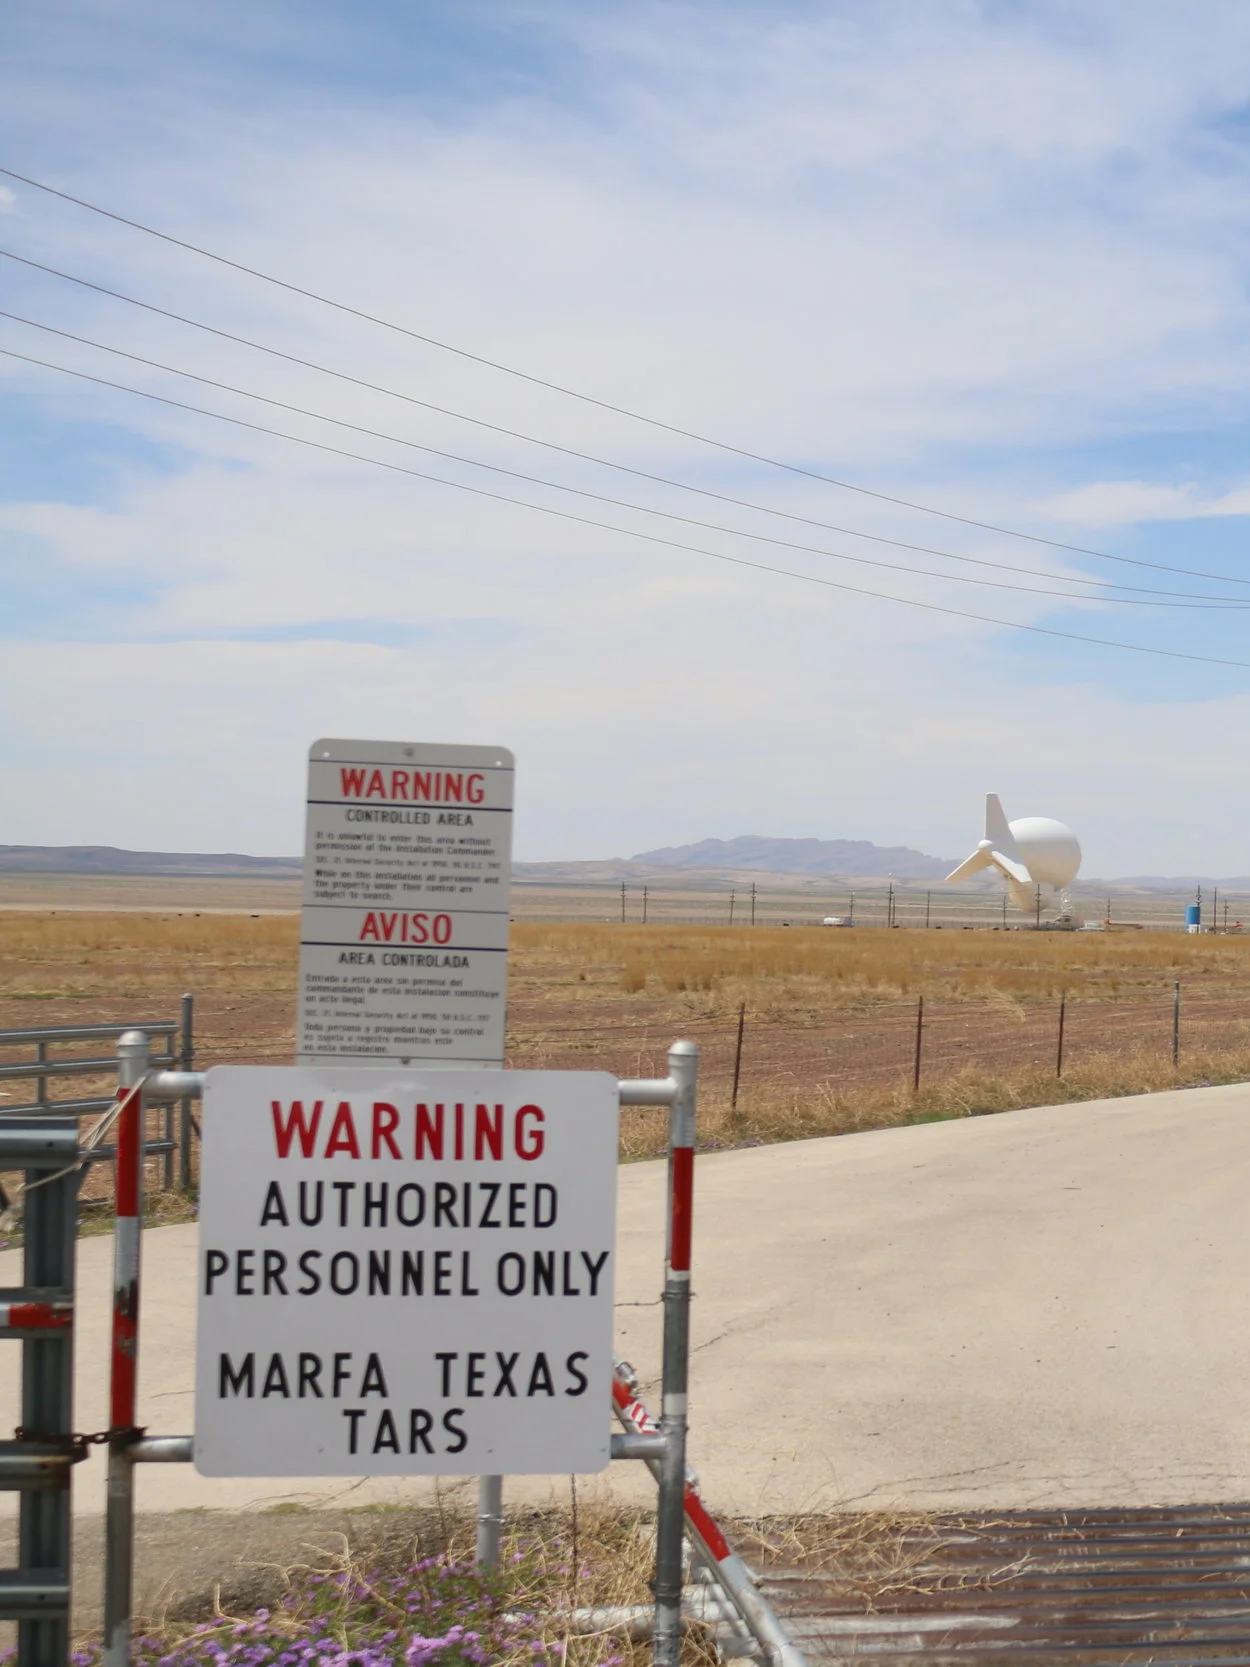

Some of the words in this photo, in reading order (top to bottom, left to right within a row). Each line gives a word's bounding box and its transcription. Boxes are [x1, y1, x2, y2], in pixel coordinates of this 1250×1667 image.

[340, 768, 484, 803] WARNING
[346, 810, 431, 825] CONTROLLED
[438, 814, 473, 826] AREA
[359, 912, 452, 944] AVISO
[339, 952, 374, 964] AREA
[382, 952, 470, 968] CONTROLADA
[271, 1100, 544, 1160] WARNING
[260, 1181, 557, 1228] AUTHORIZED
[205, 1250, 478, 1296] PERSONNEL
[498, 1251, 609, 1296] ONLY
[220, 1352, 388, 1398] MARFA
[435, 1351, 588, 1397] TEXAS
[343, 1408, 467, 1454] TARS
